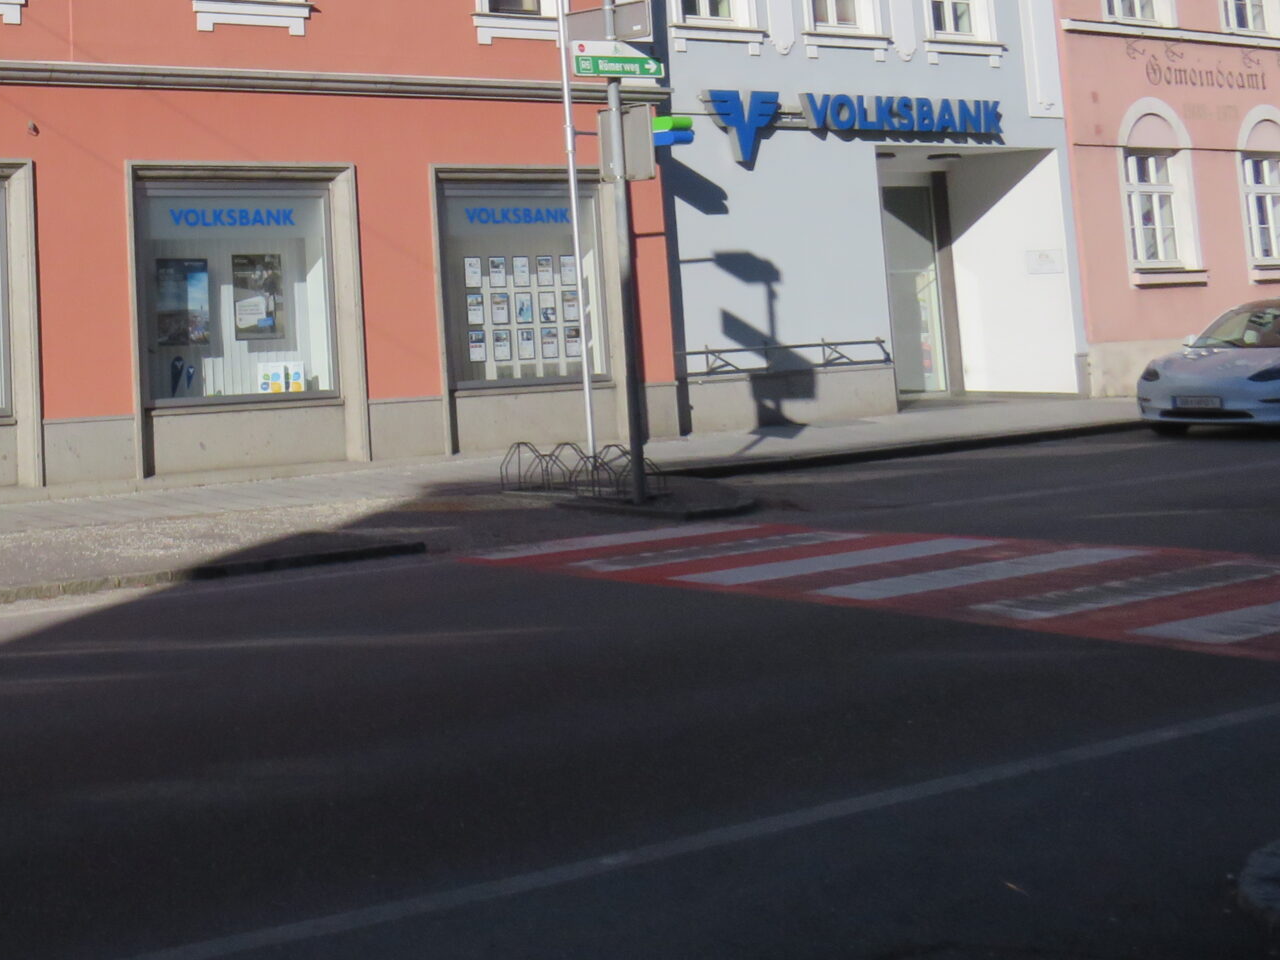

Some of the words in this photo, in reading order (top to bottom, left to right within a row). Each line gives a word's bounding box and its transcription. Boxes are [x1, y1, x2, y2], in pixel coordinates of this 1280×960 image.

[799, 92, 1004, 134] VOLKSBANK
[170, 208, 296, 227] VOLKSBANK
[465, 207, 570, 224] VOLKSBANK
